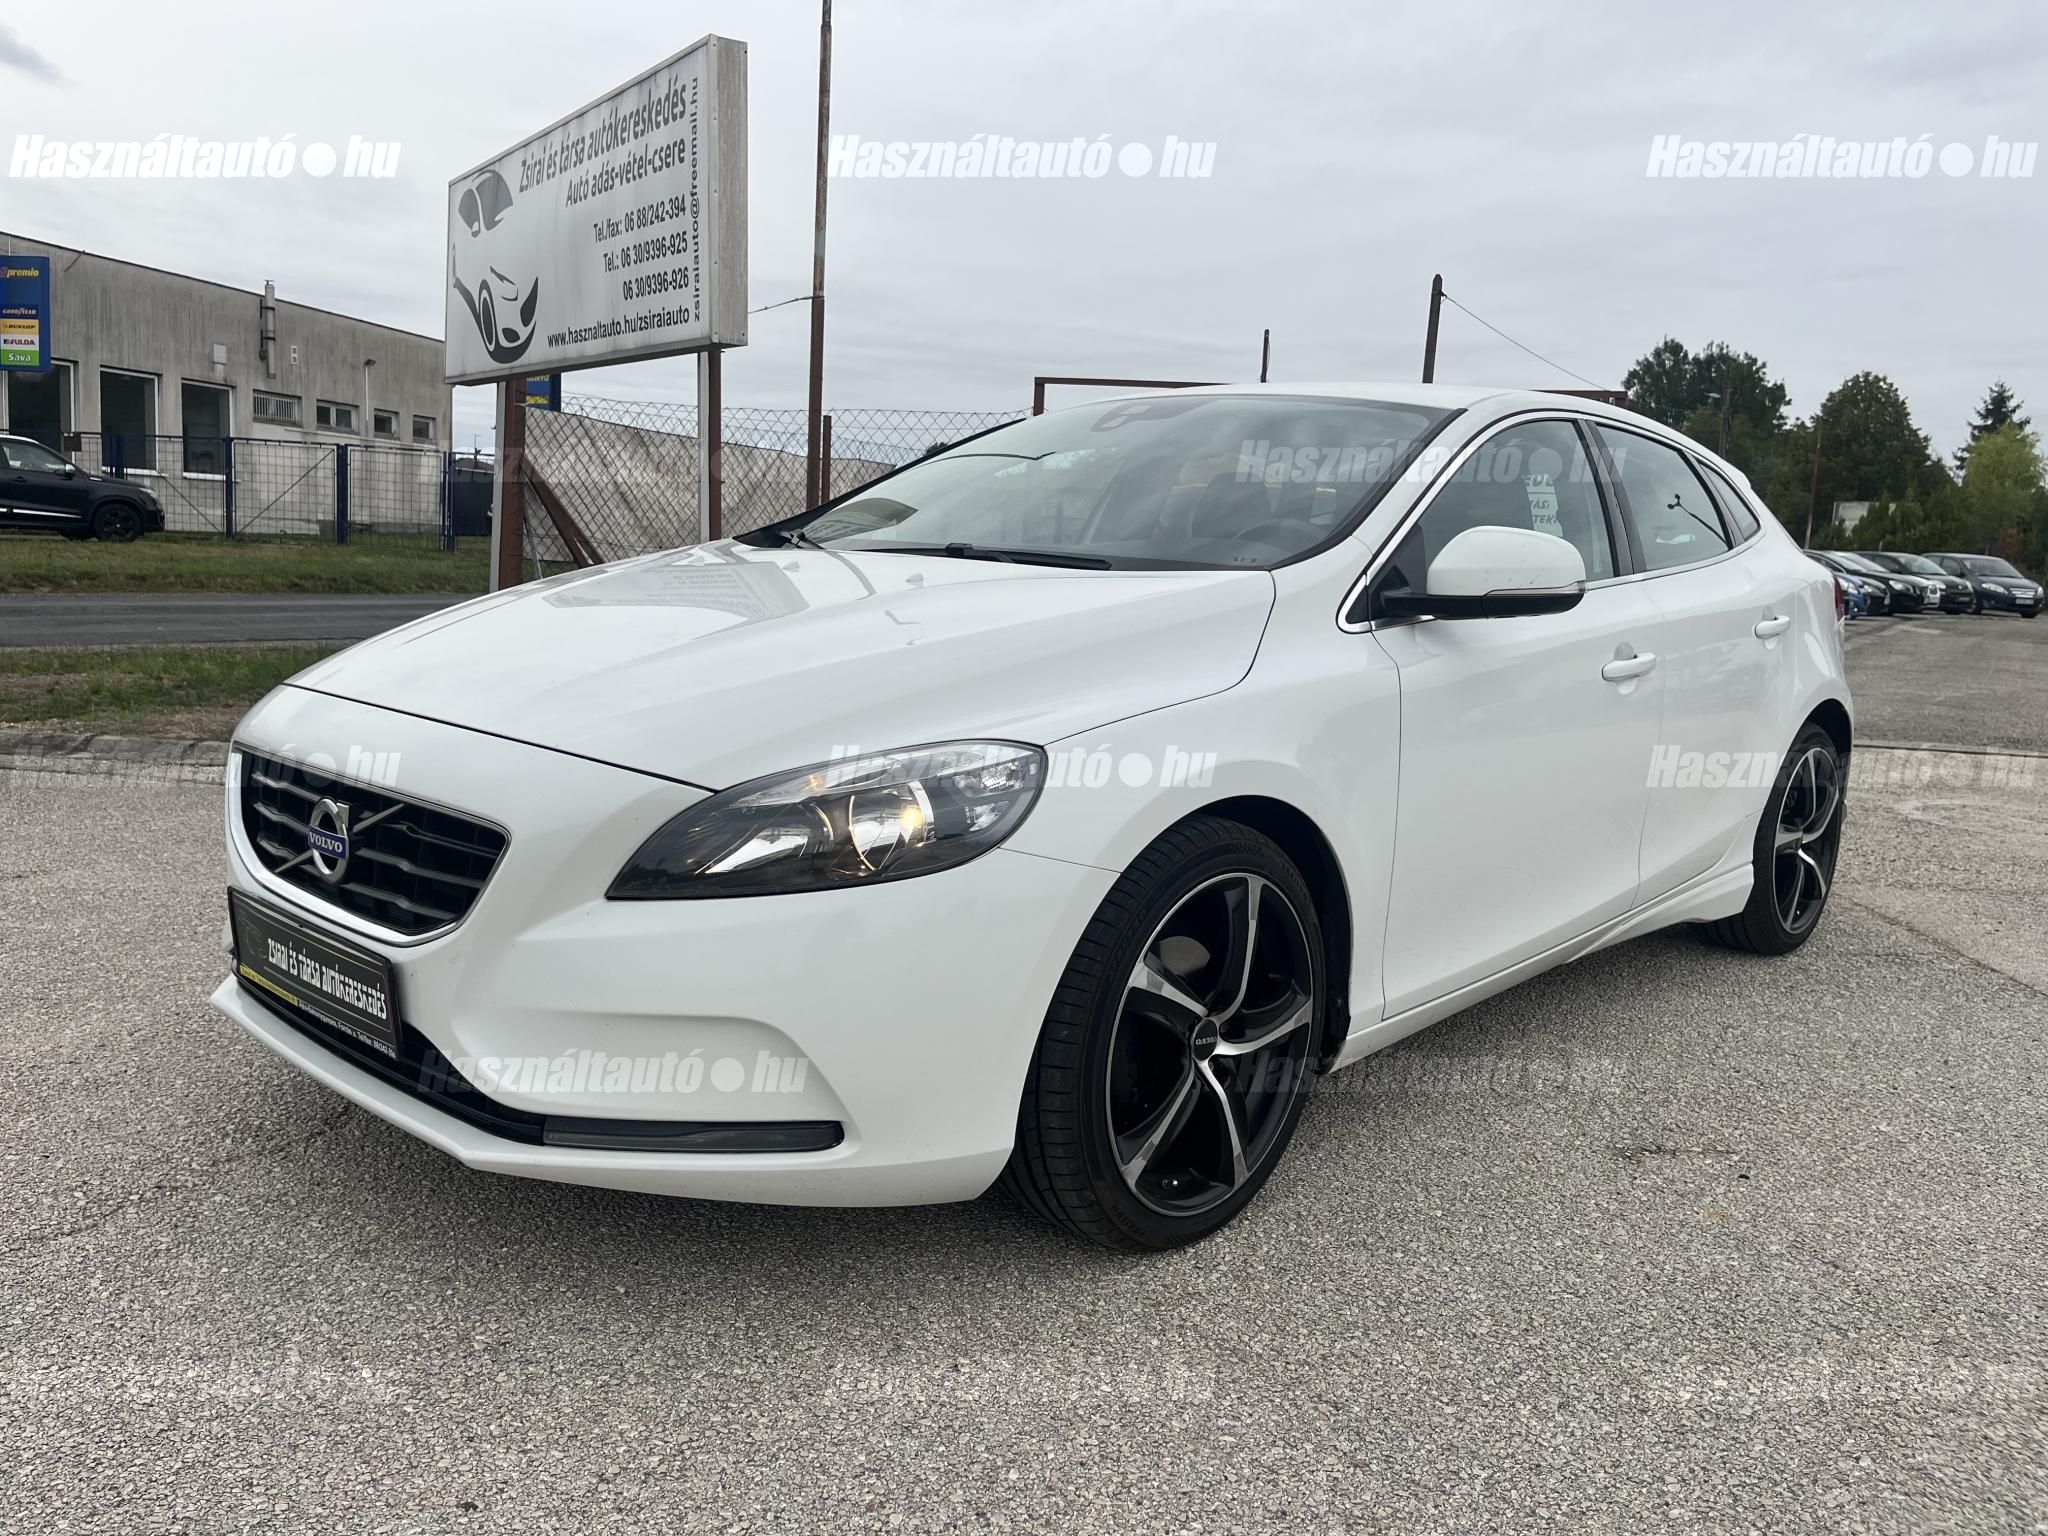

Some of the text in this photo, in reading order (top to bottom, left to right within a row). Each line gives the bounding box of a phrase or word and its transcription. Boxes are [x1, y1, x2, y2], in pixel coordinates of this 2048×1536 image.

[519, 75, 687, 193] Zsirai és társa autókereskedés
[566, 138, 686, 208] Autó adás-vétel-csere
[593, 193, 686, 243] Tel./fax: 06 88/242-394
[690, 77, 700, 322] zsiraiauto@freemail.hu
[7, 267, 39, 278] premio
[603, 230, 688, 273] Tel.: 06 30/9396-925
[623, 266, 689, 301] 06 30/9396-926
[547, 304, 690, 348] www.hasznaltauto.hu/zsiraiauto
[8, 353, 31, 362] Sava
[309, 831, 343, 854] VOLVO
[289, 941, 298, 976] ÉS
